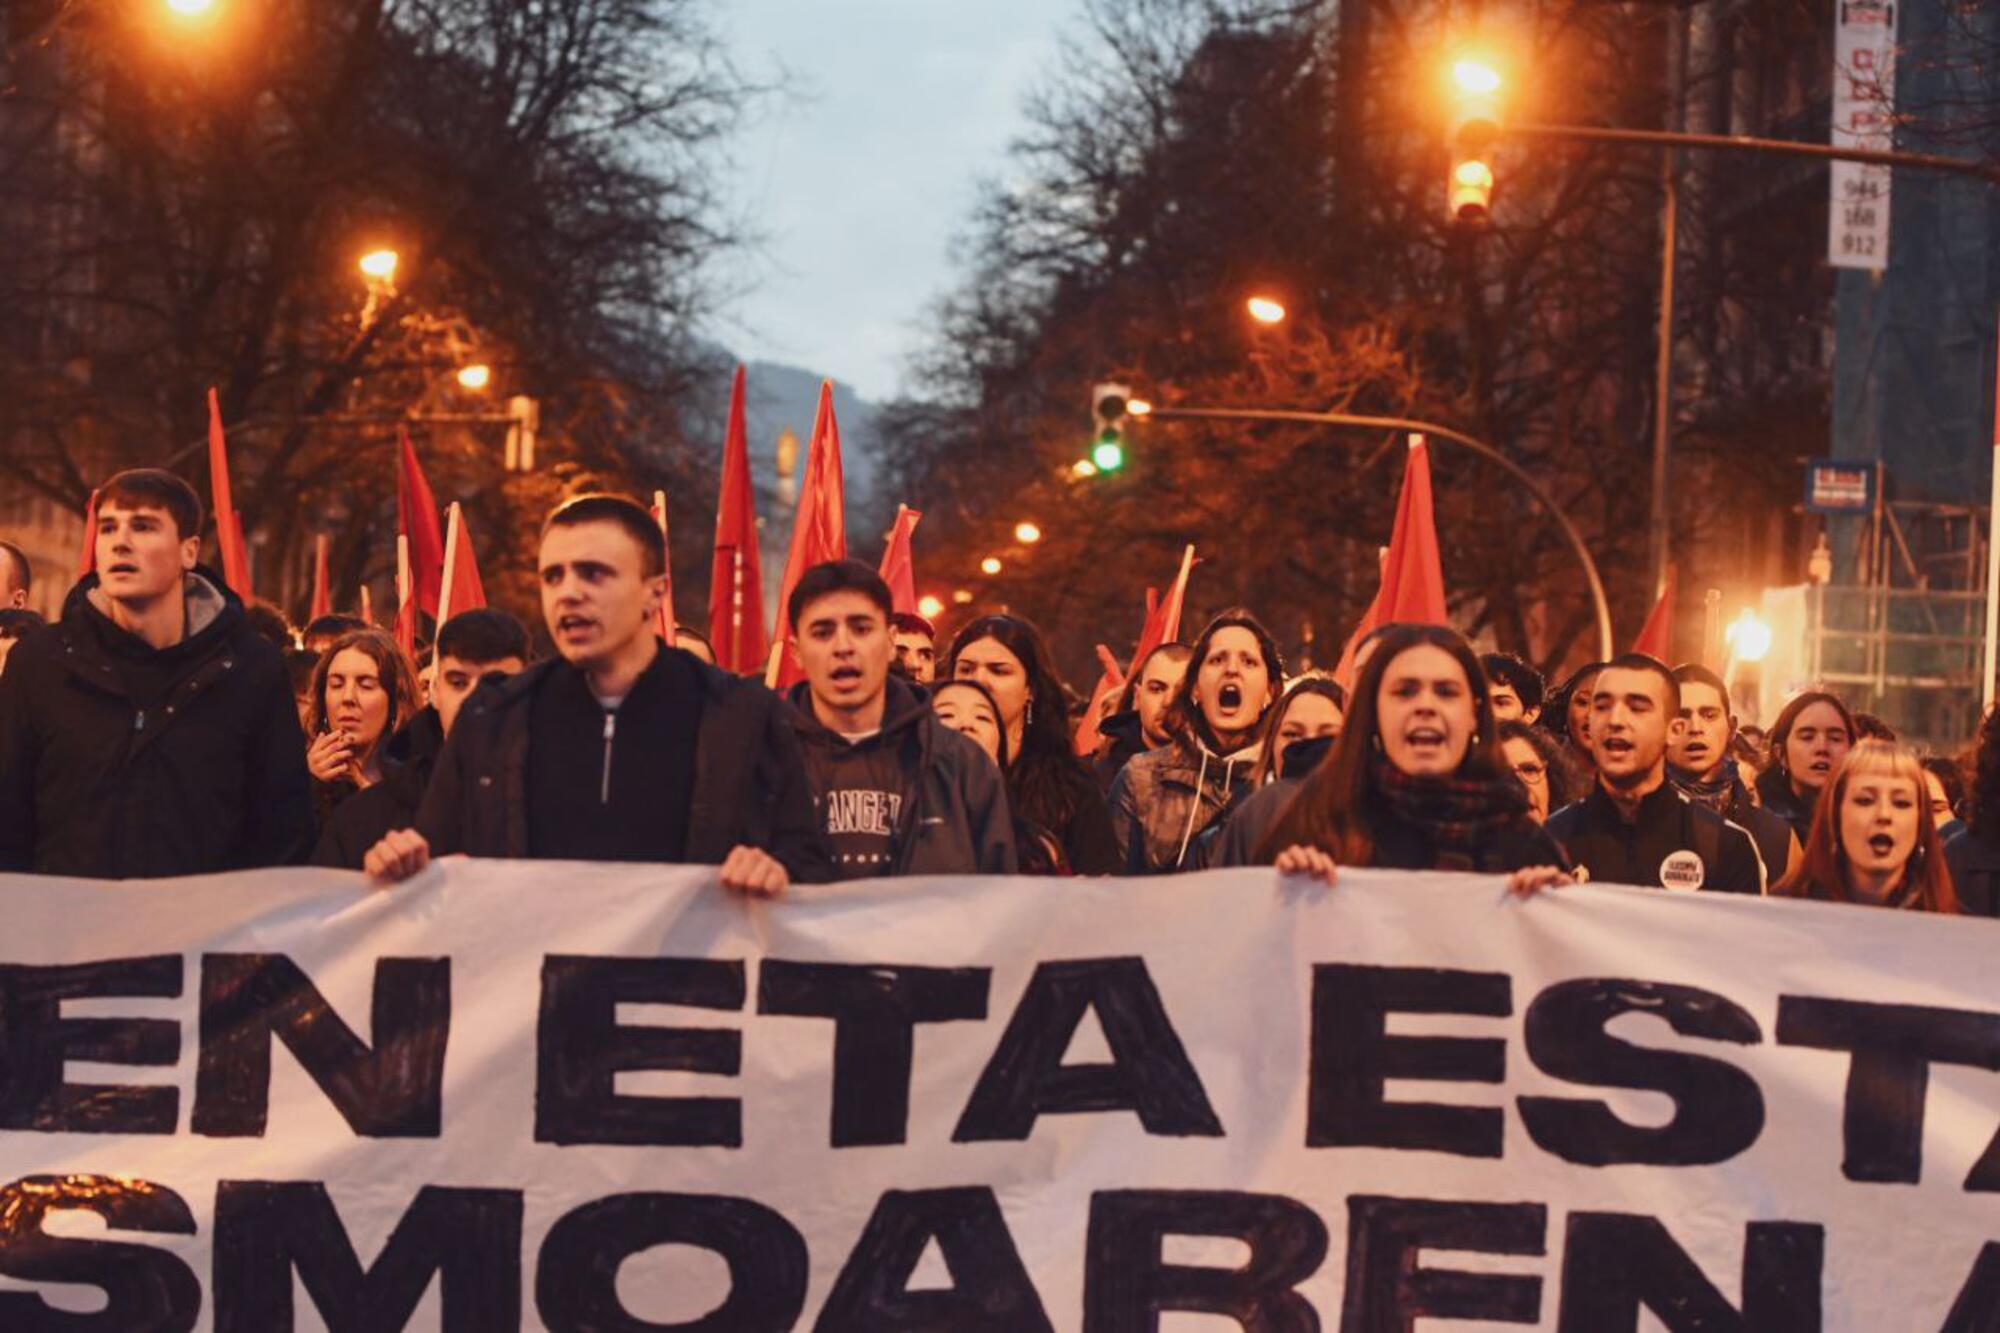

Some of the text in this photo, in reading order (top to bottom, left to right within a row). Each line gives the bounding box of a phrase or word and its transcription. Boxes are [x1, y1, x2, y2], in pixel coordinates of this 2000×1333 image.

[1842, 234, 1876, 254] 912
[534, 954, 1225, 1148] ETA
[1305, 962, 2000, 1193] EST
